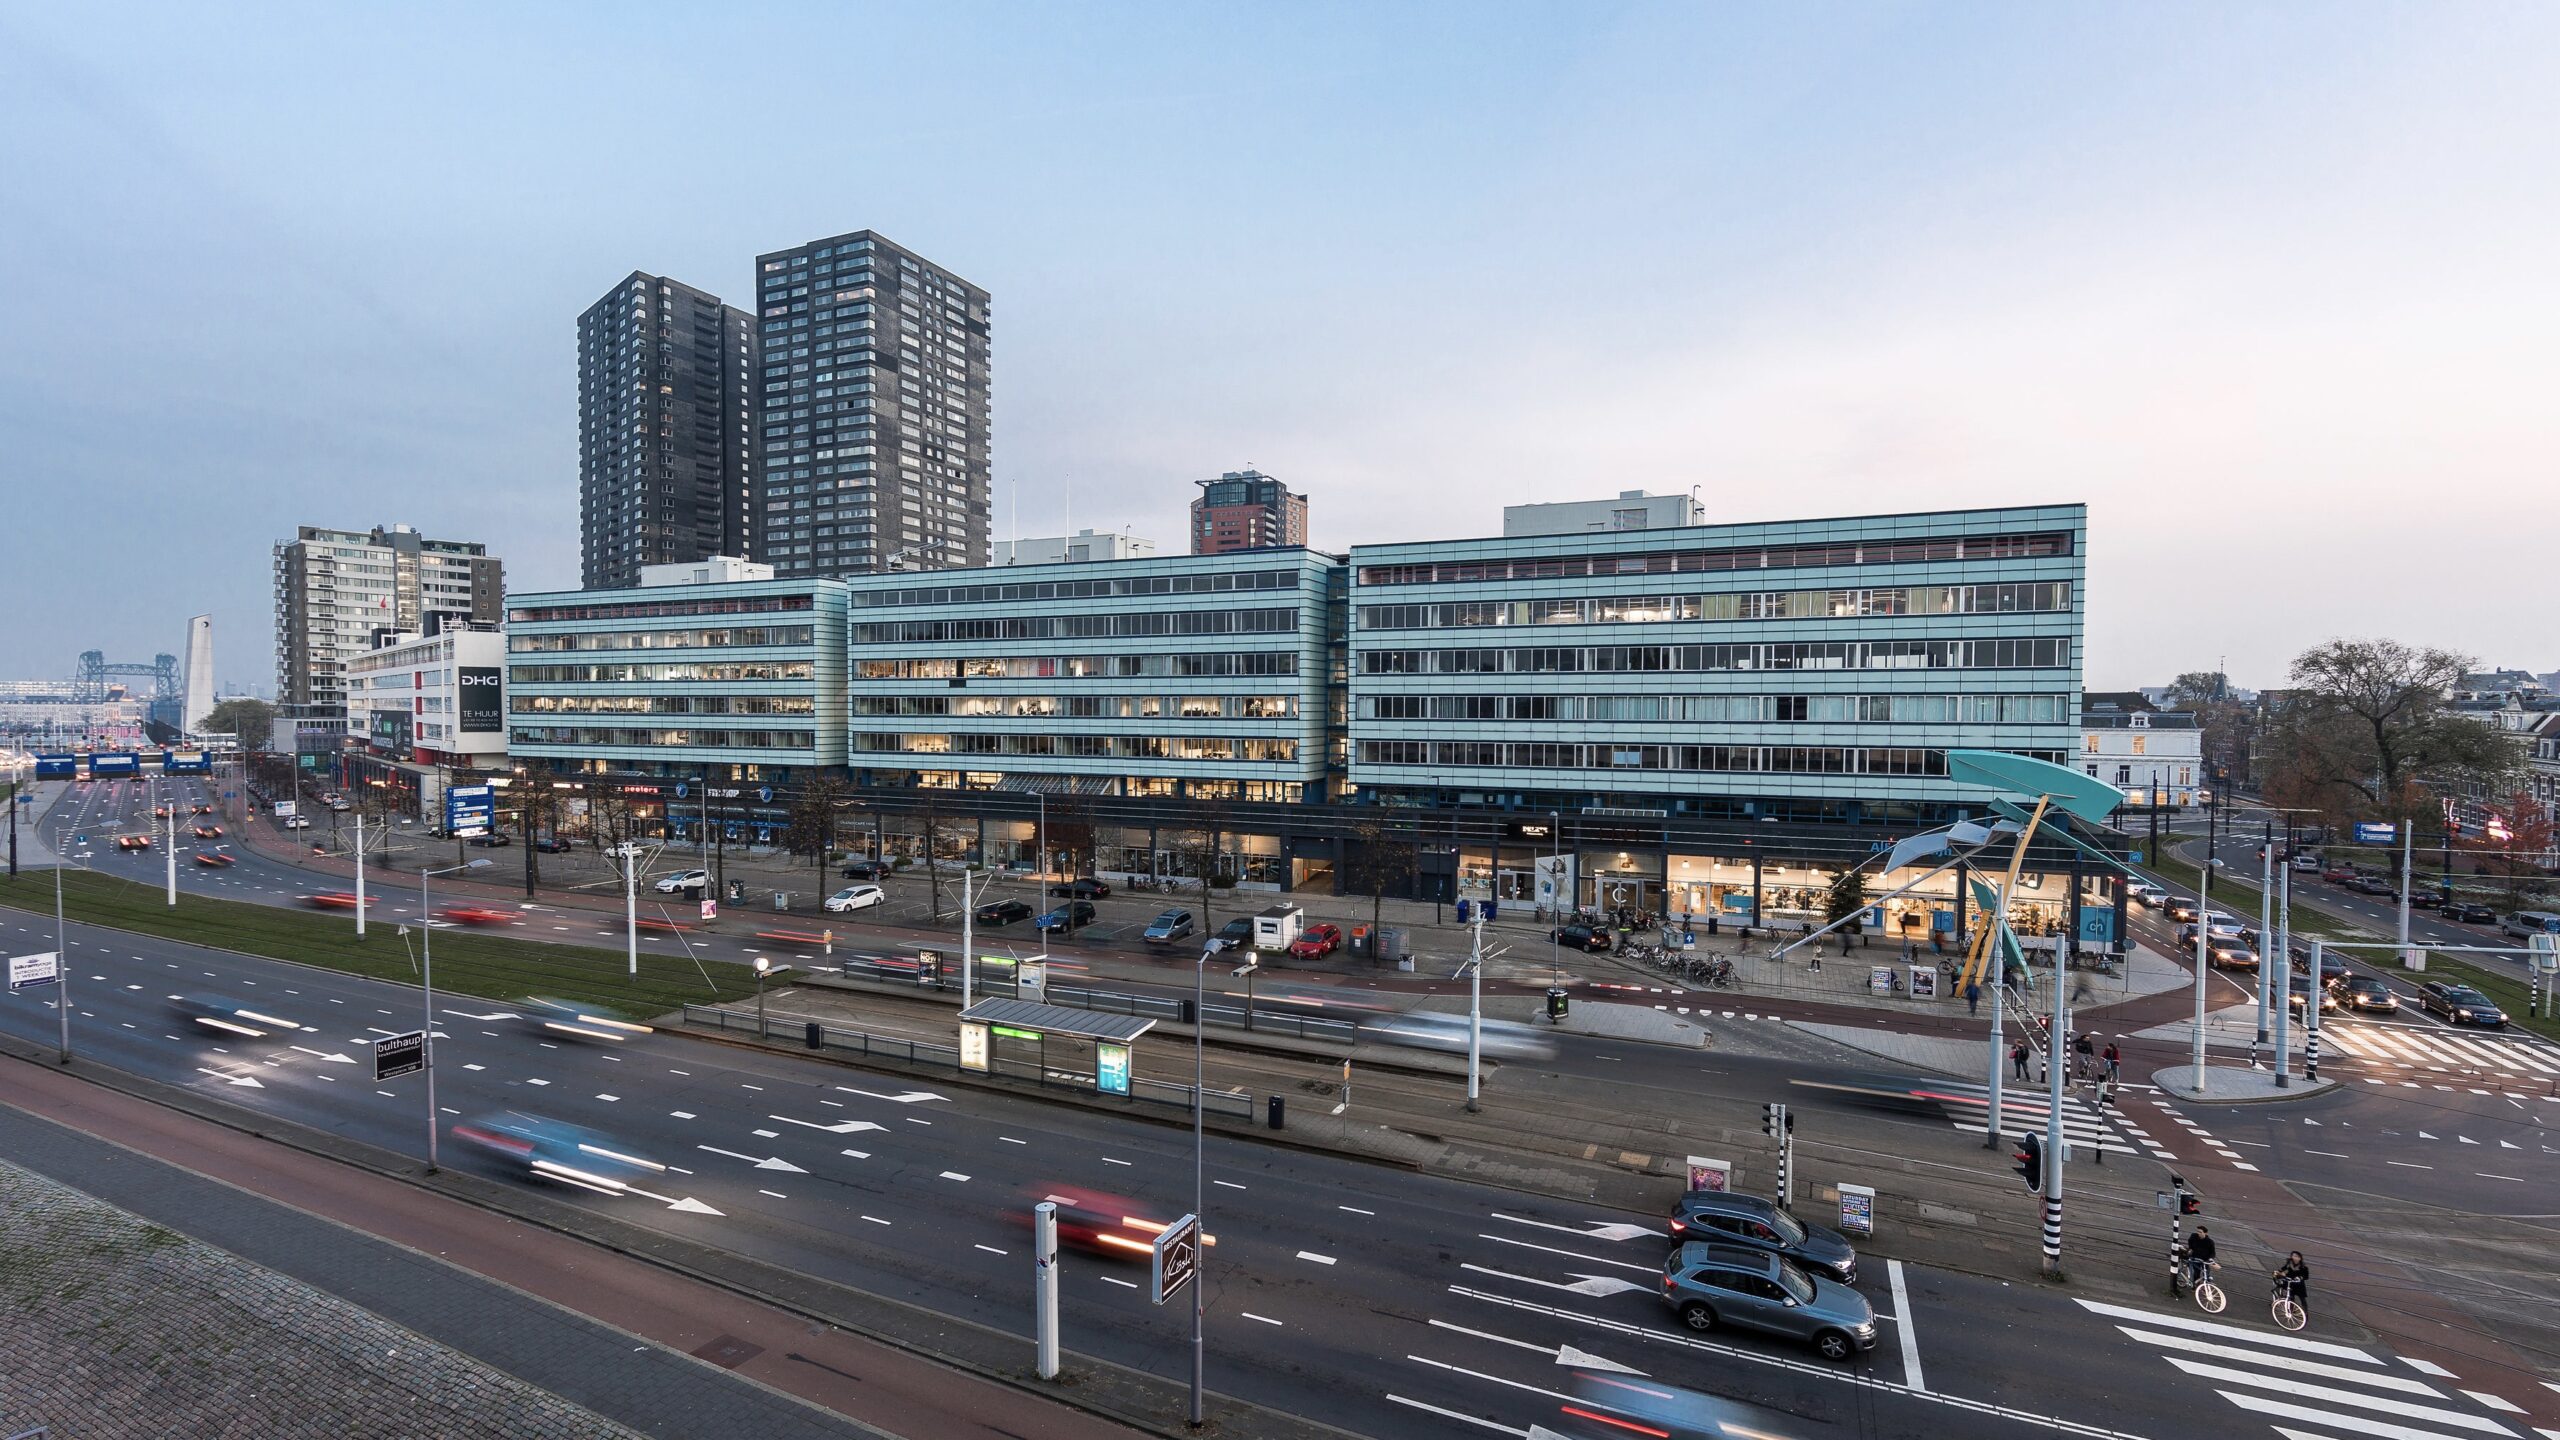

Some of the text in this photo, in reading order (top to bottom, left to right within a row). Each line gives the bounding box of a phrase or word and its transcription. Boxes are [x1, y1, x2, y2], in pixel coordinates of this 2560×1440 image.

[461, 675, 498, 686] DHG
[463, 710, 499, 718] TE HUUR
[377, 1036, 421, 1052] bulthaup
[1163, 1223, 1195, 1251] RESTAURANT
